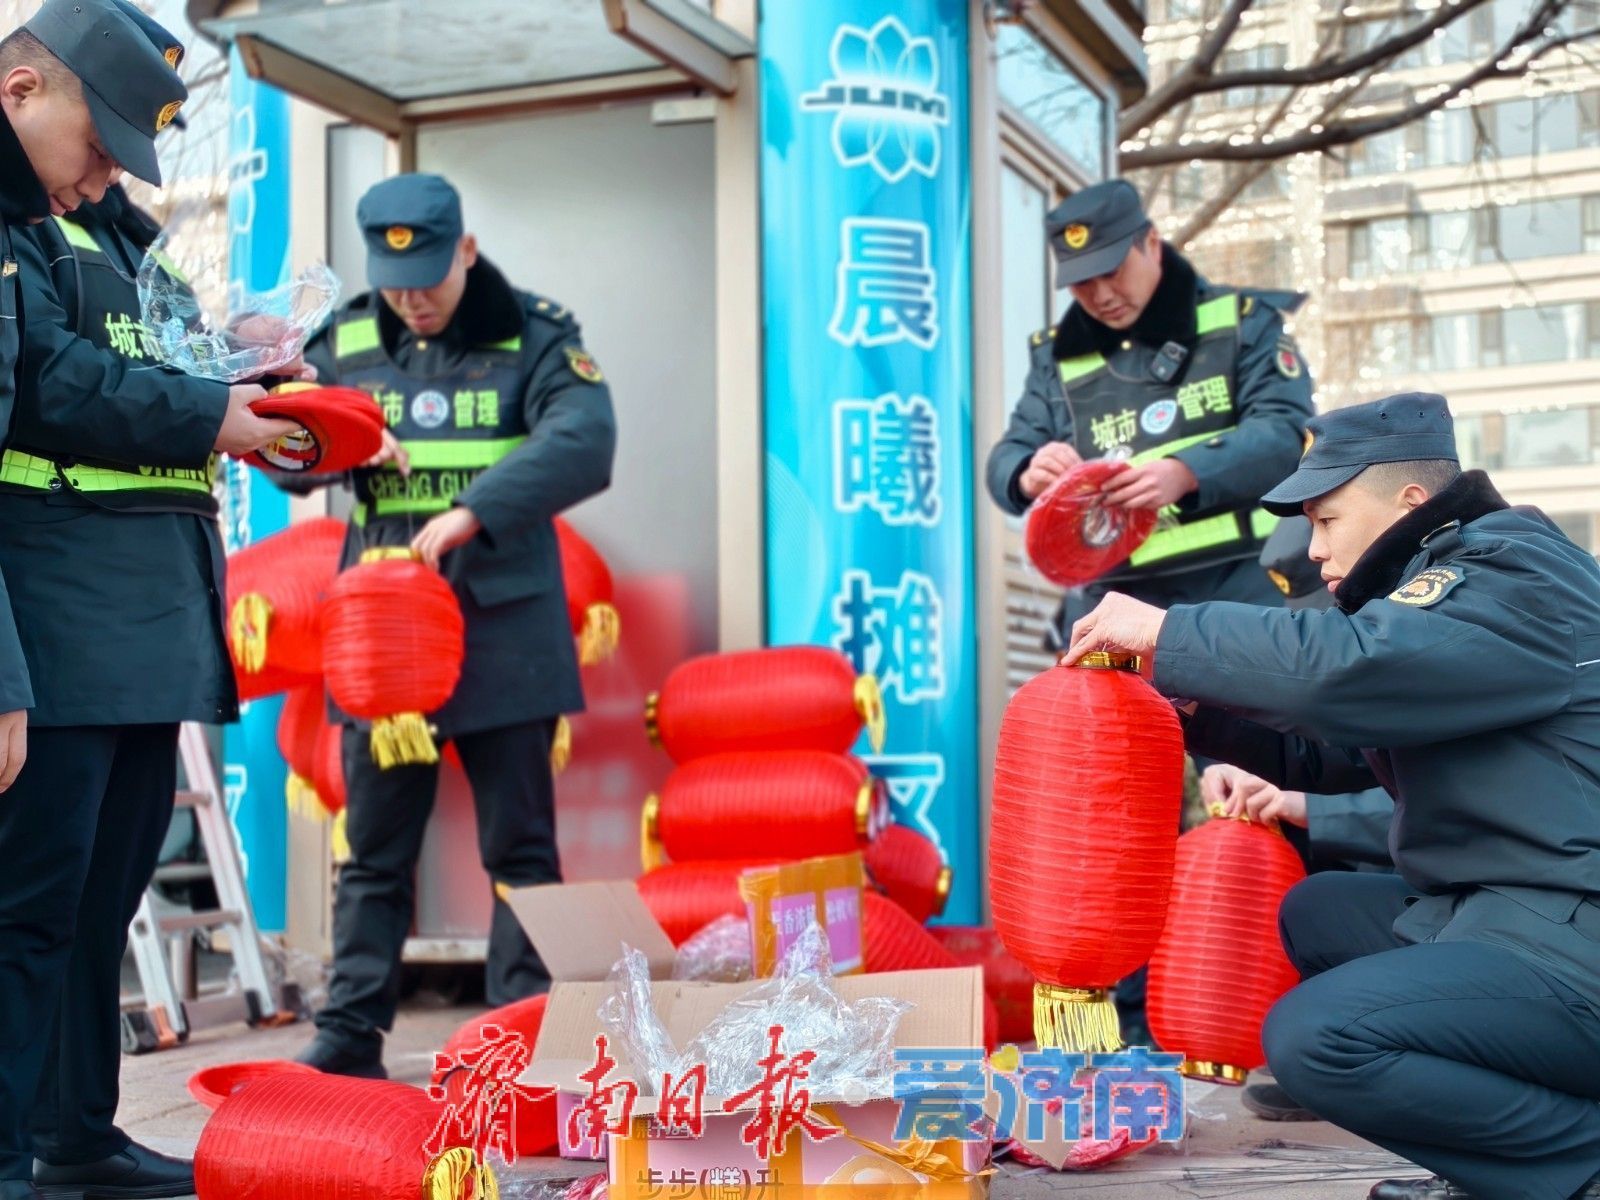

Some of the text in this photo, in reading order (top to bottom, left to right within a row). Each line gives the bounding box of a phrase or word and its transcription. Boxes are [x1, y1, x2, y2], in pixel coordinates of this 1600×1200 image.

[373, 389, 499, 428] 市 管理
[1091, 374, 1232, 450] 城市 管理
[438, 471, 479, 499] GU
